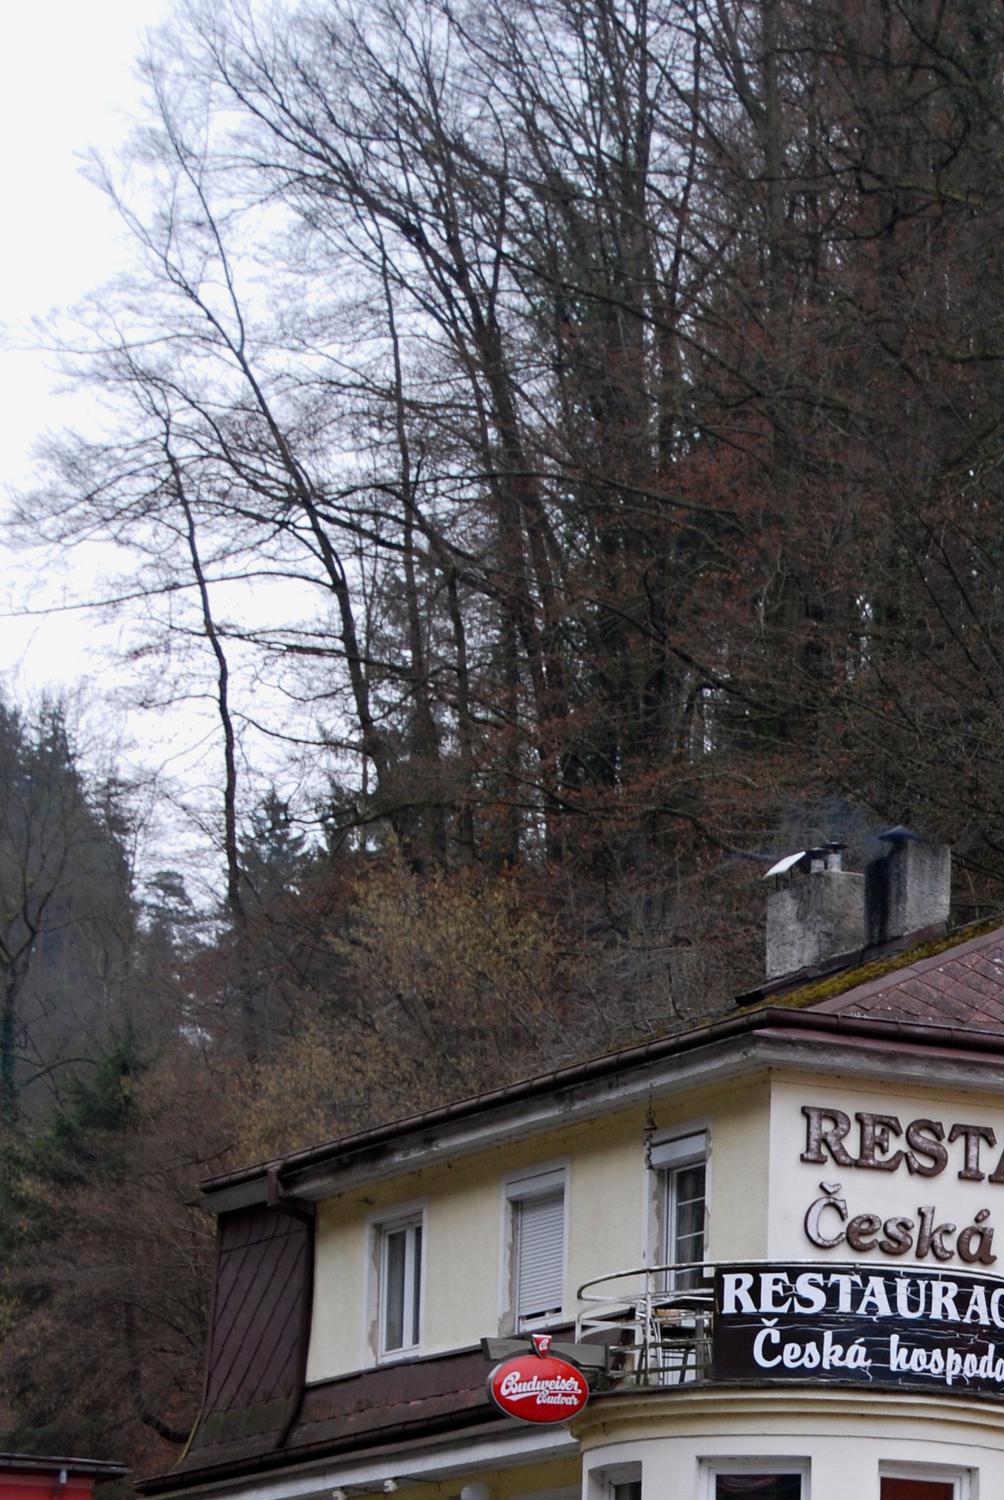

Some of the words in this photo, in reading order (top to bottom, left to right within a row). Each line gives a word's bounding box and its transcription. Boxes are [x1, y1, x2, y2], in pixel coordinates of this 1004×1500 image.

[804, 1181, 998, 1265] Česká
[753, 1317, 872, 1369] Česká
[500, 1371, 582, 1400] Budweiser
[536, 1389, 580, 1406] Budvar
